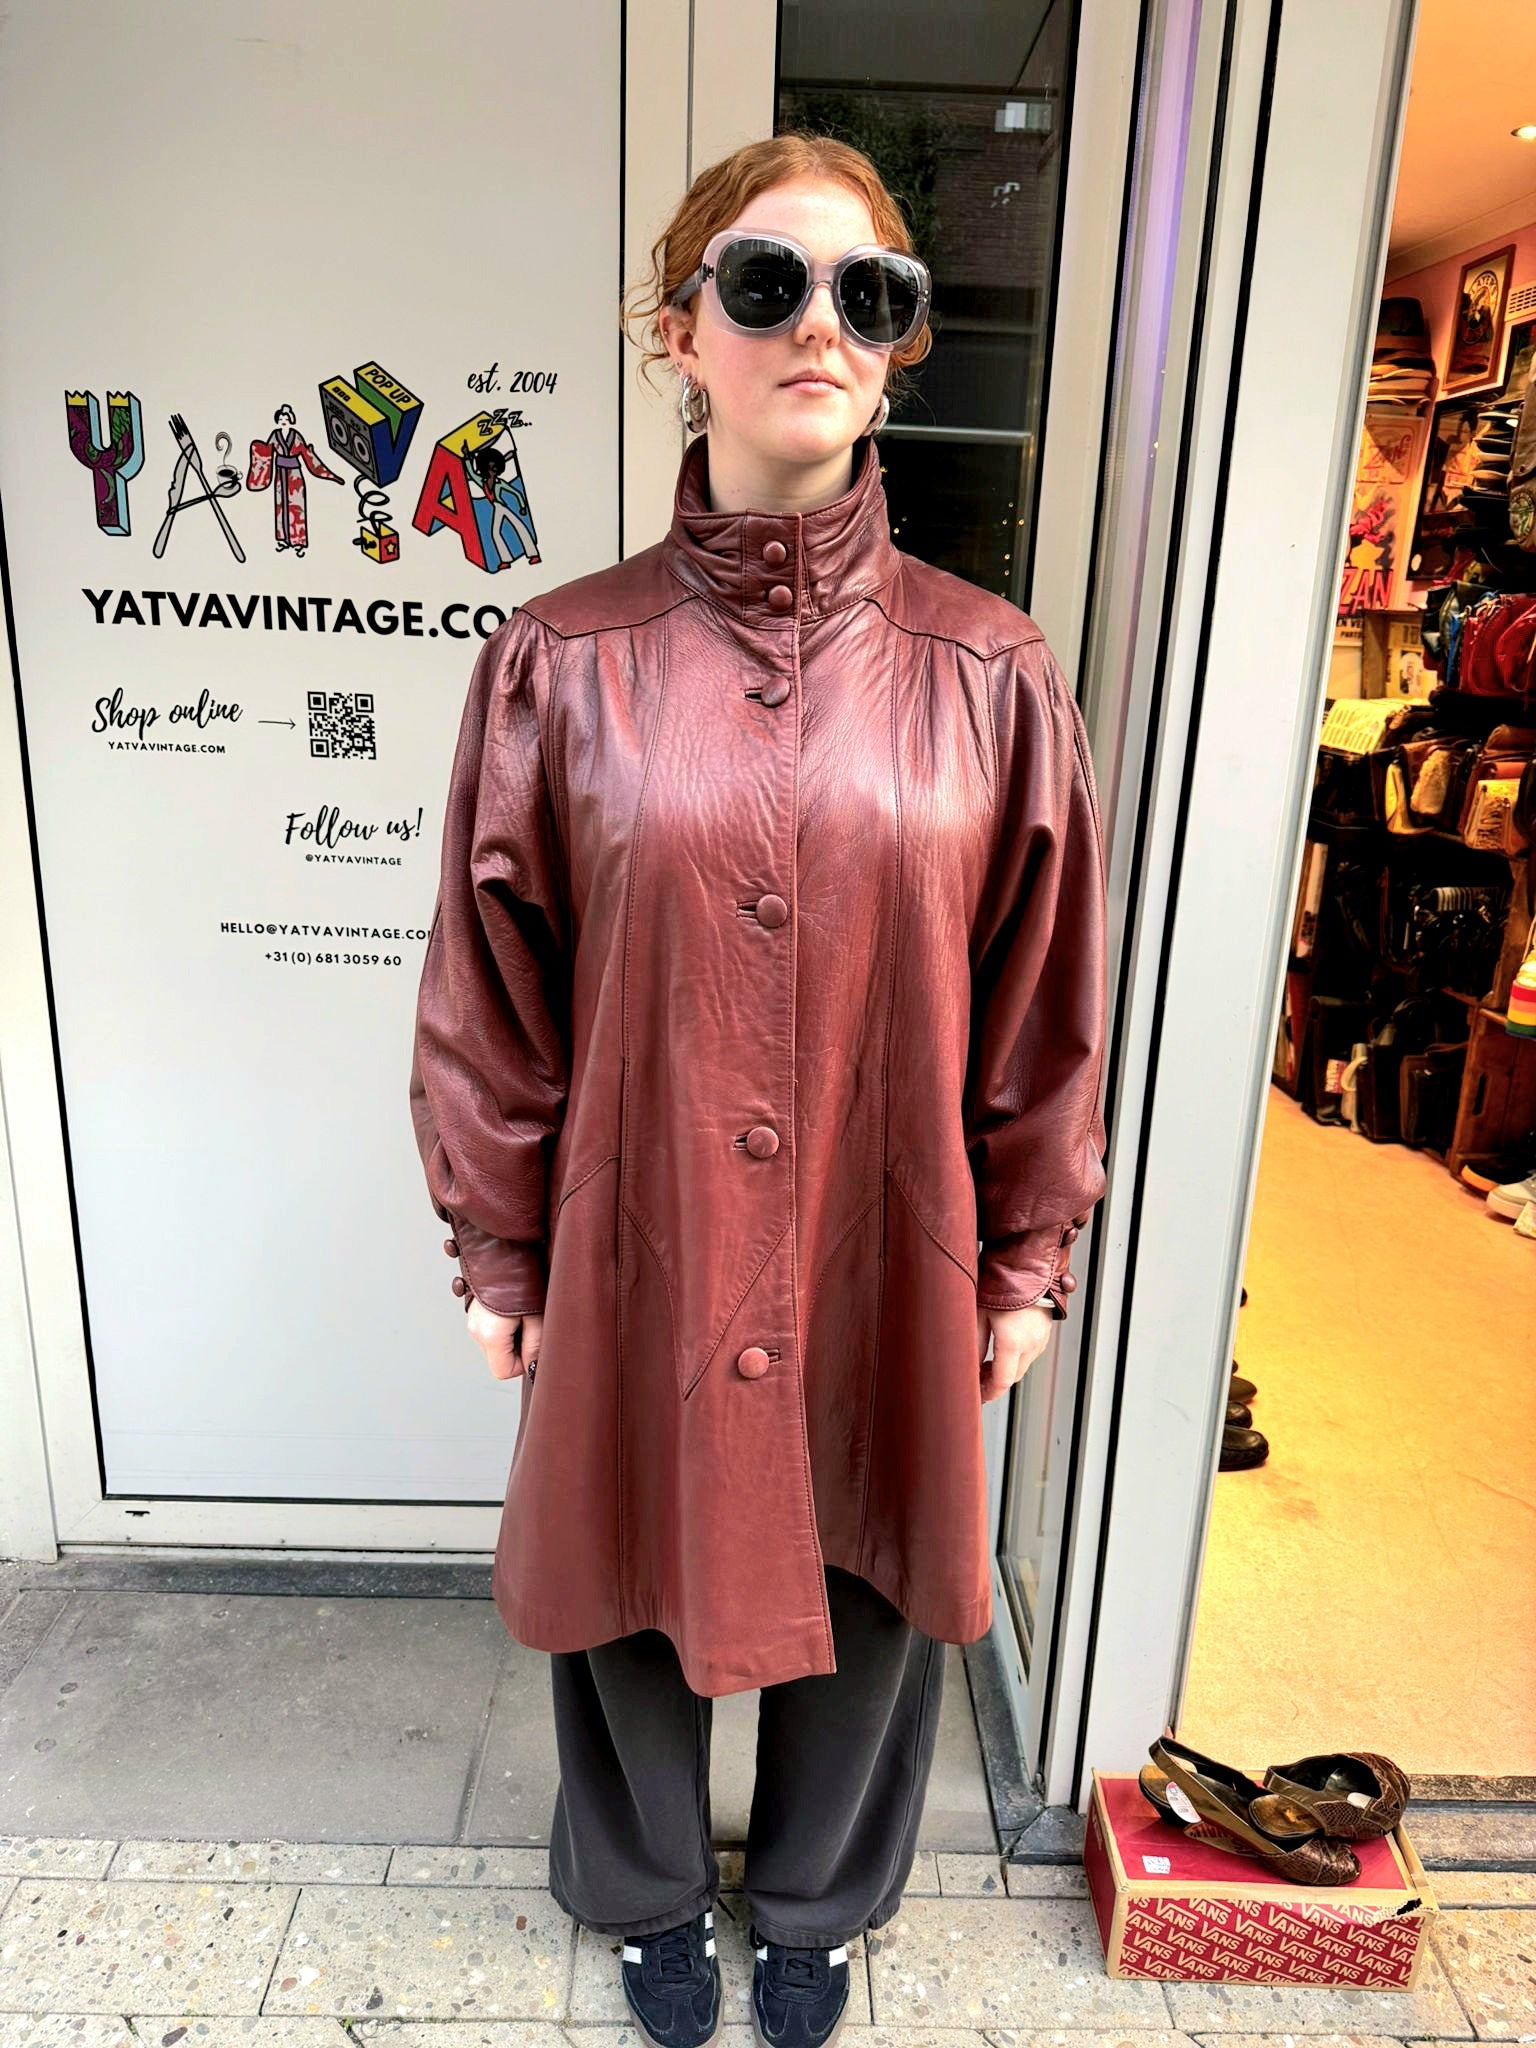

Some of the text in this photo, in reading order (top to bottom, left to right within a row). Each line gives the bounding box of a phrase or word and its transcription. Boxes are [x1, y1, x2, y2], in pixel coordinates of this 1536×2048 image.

[365, 368, 411, 404] POP UP
[467, 362, 558, 394] est. 2004
[91, 687, 243, 741] Shop online
[108, 741, 226, 754] YATVAVINTAGE.COM
[285, 804, 424, 849] Follow us!
[305, 854, 402, 866] @YATVAVINTAGE
[220, 922, 430, 940] HELLO@YATVAVINTAGE.CO
[383, 956, 402, 966] 60
[1155, 1898, 1199, 1931] VANS
[1201, 1921, 1243, 1950] VANS
[1245, 1941, 1288, 1968] VANS
[1288, 1960, 1330, 1983] VANS
[1234, 1913, 1278, 1945] VANS
[1279, 1937, 1321, 1963] VANS
[1322, 1954, 1364, 1980] VANS
[1268, 1906, 1312, 1939] VANS
[1313, 1931, 1355, 1958] VANS
[1357, 1949, 1398, 1975] VANS
[1301, 1902, 1346, 1934] VANS
[1346, 1925, 1389, 1951] VANS
[1381, 1921, 1419, 1946] VANS
[1133, 1931, 1176, 1959] VANS
[1178, 1951, 1220, 1977] VANS
[1167, 1926, 1210, 1955] VANS
[1211, 1946, 1254, 1973] VANS
